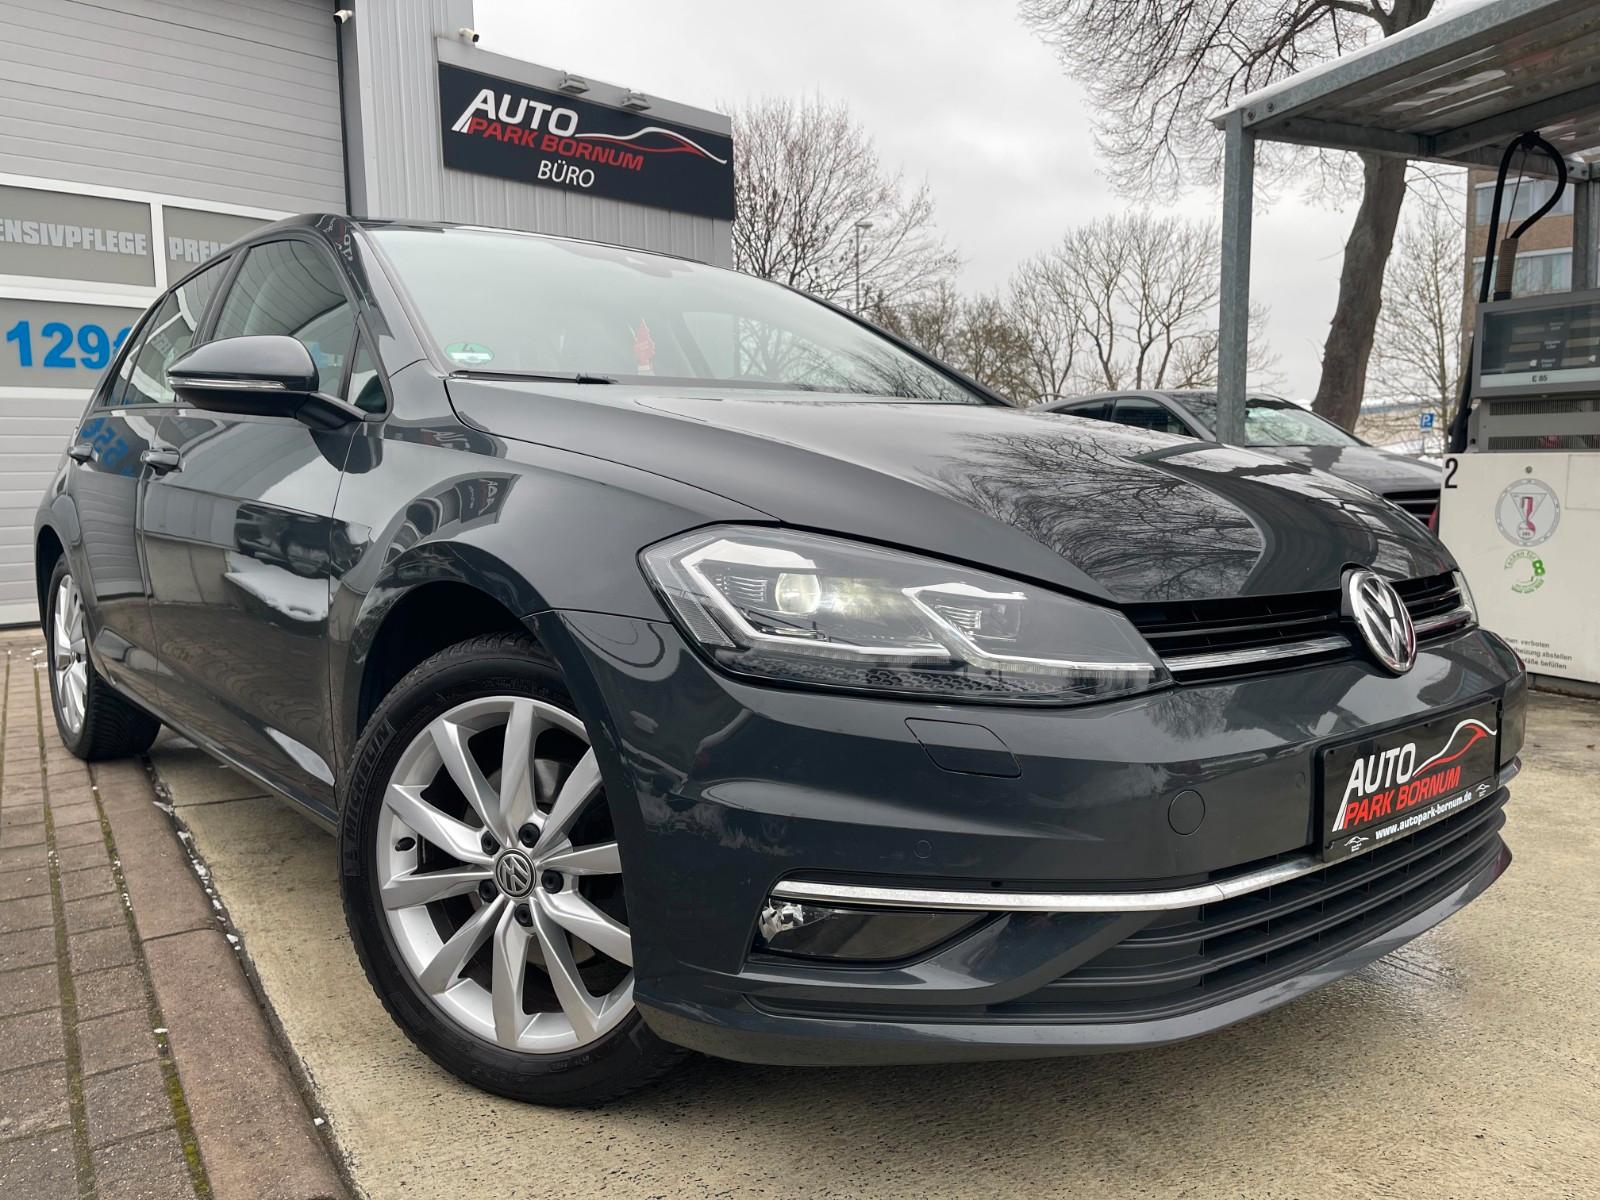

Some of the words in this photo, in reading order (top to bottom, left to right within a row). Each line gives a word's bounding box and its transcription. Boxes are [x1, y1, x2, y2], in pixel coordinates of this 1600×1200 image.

[451, 88, 579, 137] AUTO
[468, 117, 537, 148] PARK
[540, 134, 645, 172] BORNUM
[537, 160, 595, 188] BÜRO
[1444, 457, 1459, 489] 2
[1332, 742, 1416, 832] AUTO
[1343, 789, 1396, 830] PARK
[1396, 765, 1462, 811] BORNUM
[1375, 790, 1473, 840] www.autopark-bornum.de
